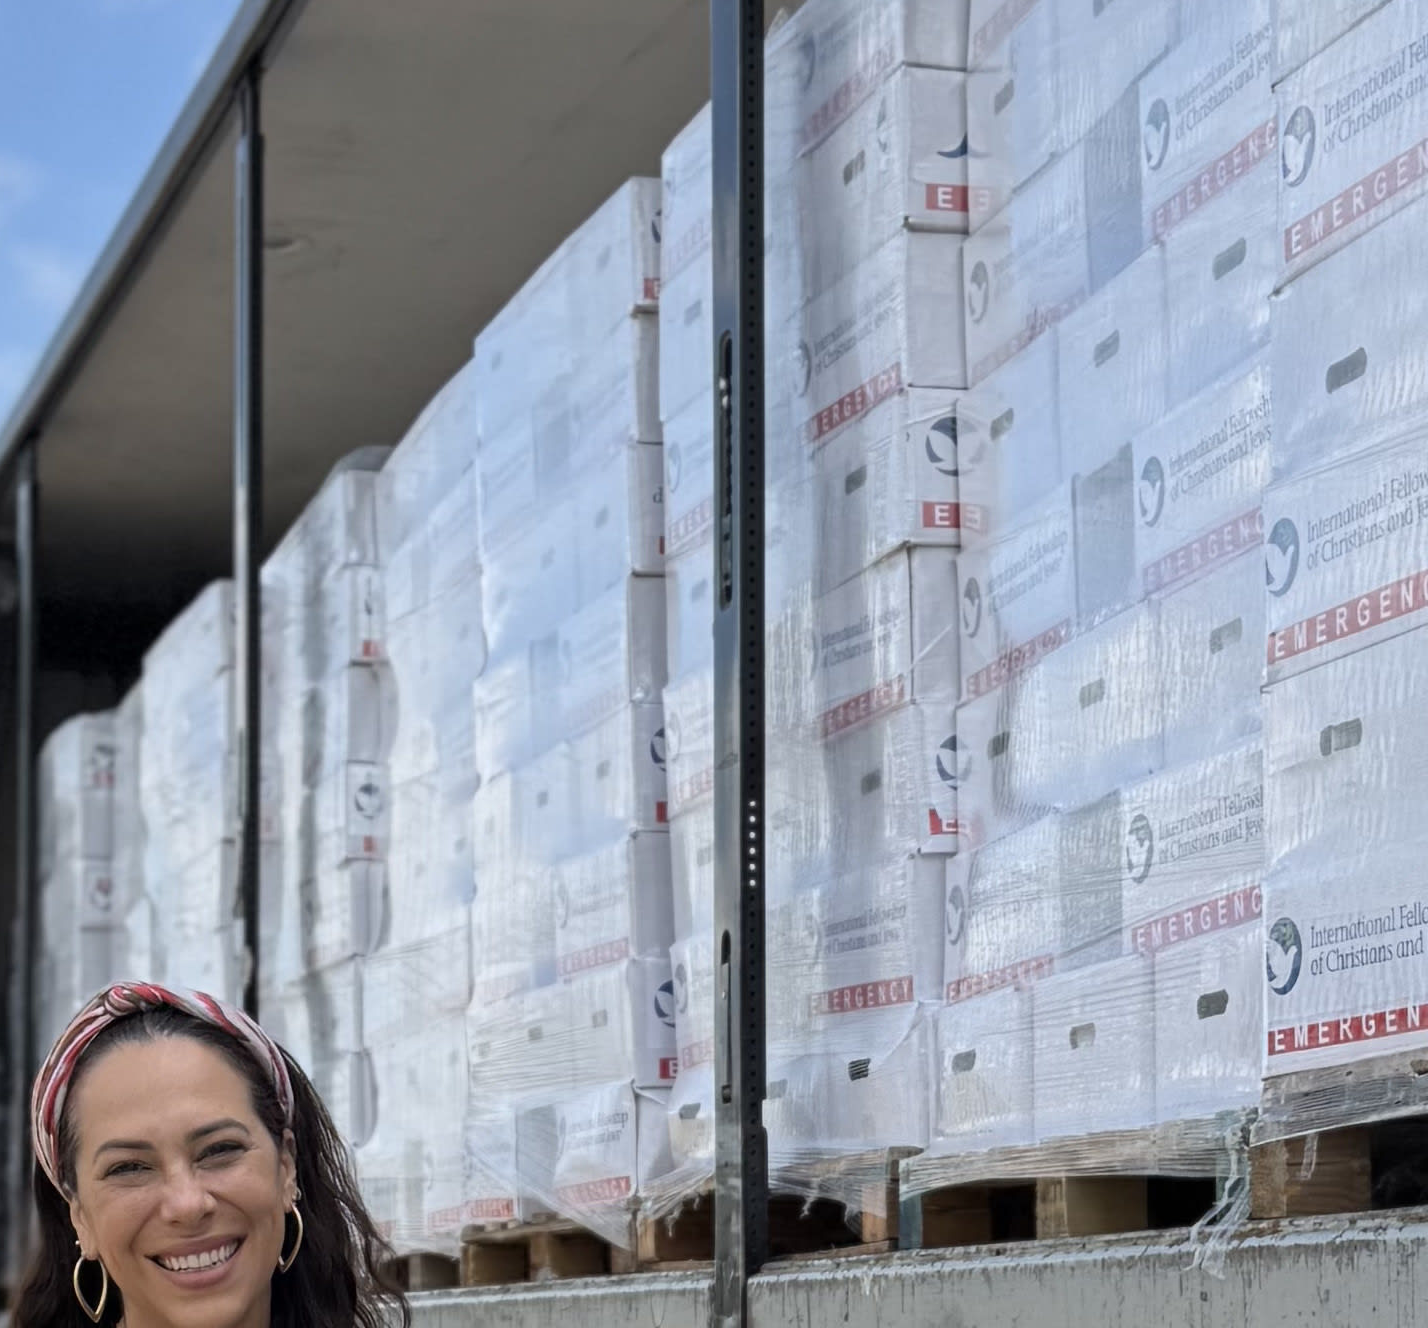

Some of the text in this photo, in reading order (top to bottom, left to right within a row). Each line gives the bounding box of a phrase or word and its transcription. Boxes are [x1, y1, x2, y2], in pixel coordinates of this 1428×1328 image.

[1324, 50, 1406, 126] International
[1323, 128, 1336, 153] of
[1338, 90, 1402, 143] Christians
[1307, 484, 1386, 543] International
[1307, 541, 1319, 570] of
[1322, 519, 1385, 563] Christians
[1387, 502, 1413, 532] and
[1311, 907, 1395, 949] International
[1311, 952, 1324, 976] of
[1326, 940, 1393, 973] Christians
[1397, 930, 1423, 958] and
